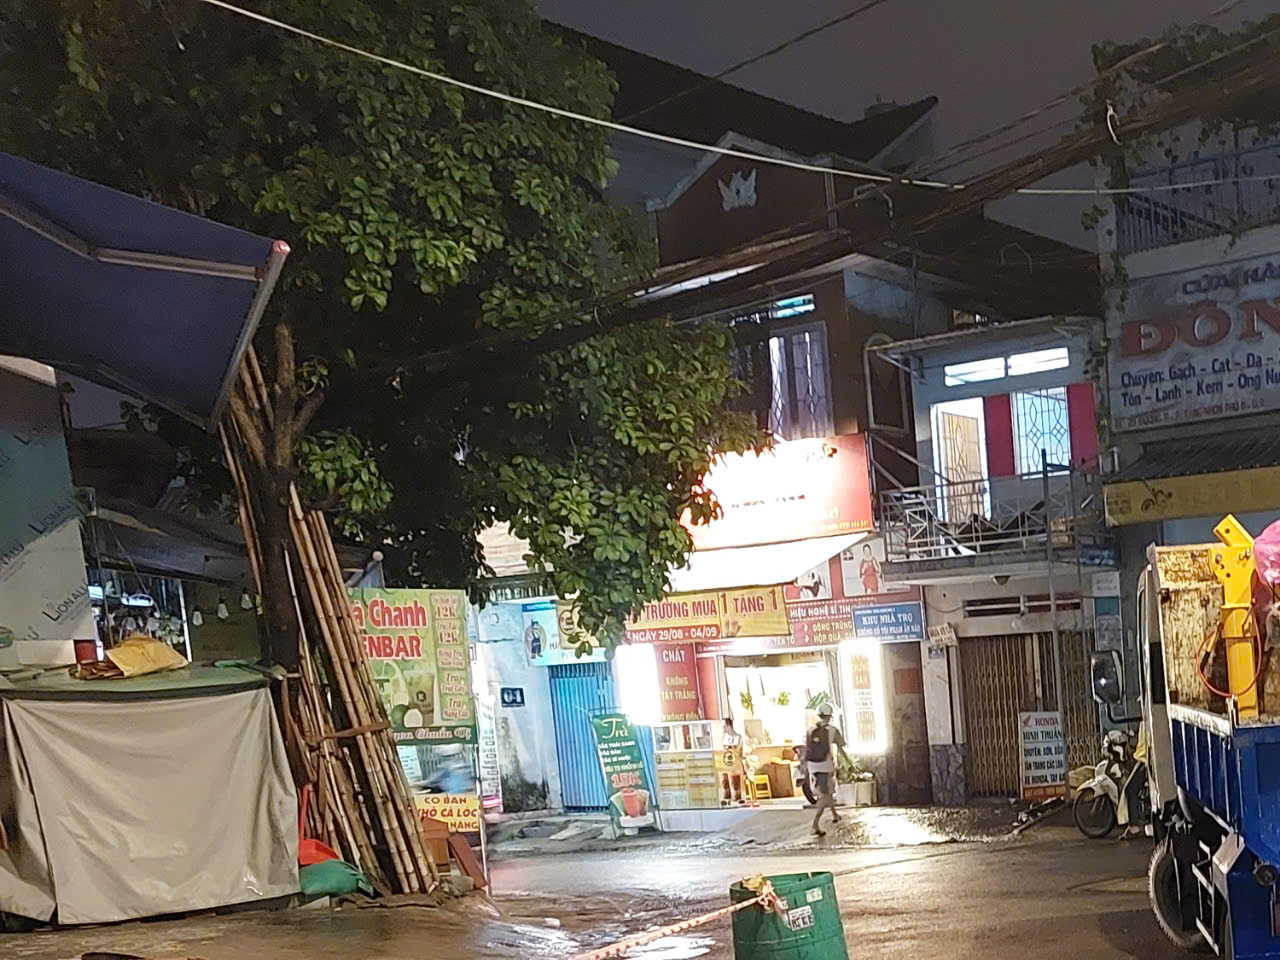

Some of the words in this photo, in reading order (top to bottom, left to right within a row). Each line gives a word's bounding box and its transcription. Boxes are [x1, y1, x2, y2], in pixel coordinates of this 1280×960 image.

[692, 600, 718, 618] MUA
[720, 593, 728, 615] 1
[769, 588, 777, 611] 1
[368, 599, 428, 627] Chanh
[658, 629, 683, 641] 29/08
[690, 626, 717, 639] 04/09
[503, 689, 523, 704] 01
[1035, 717, 1059, 727] HONDA
